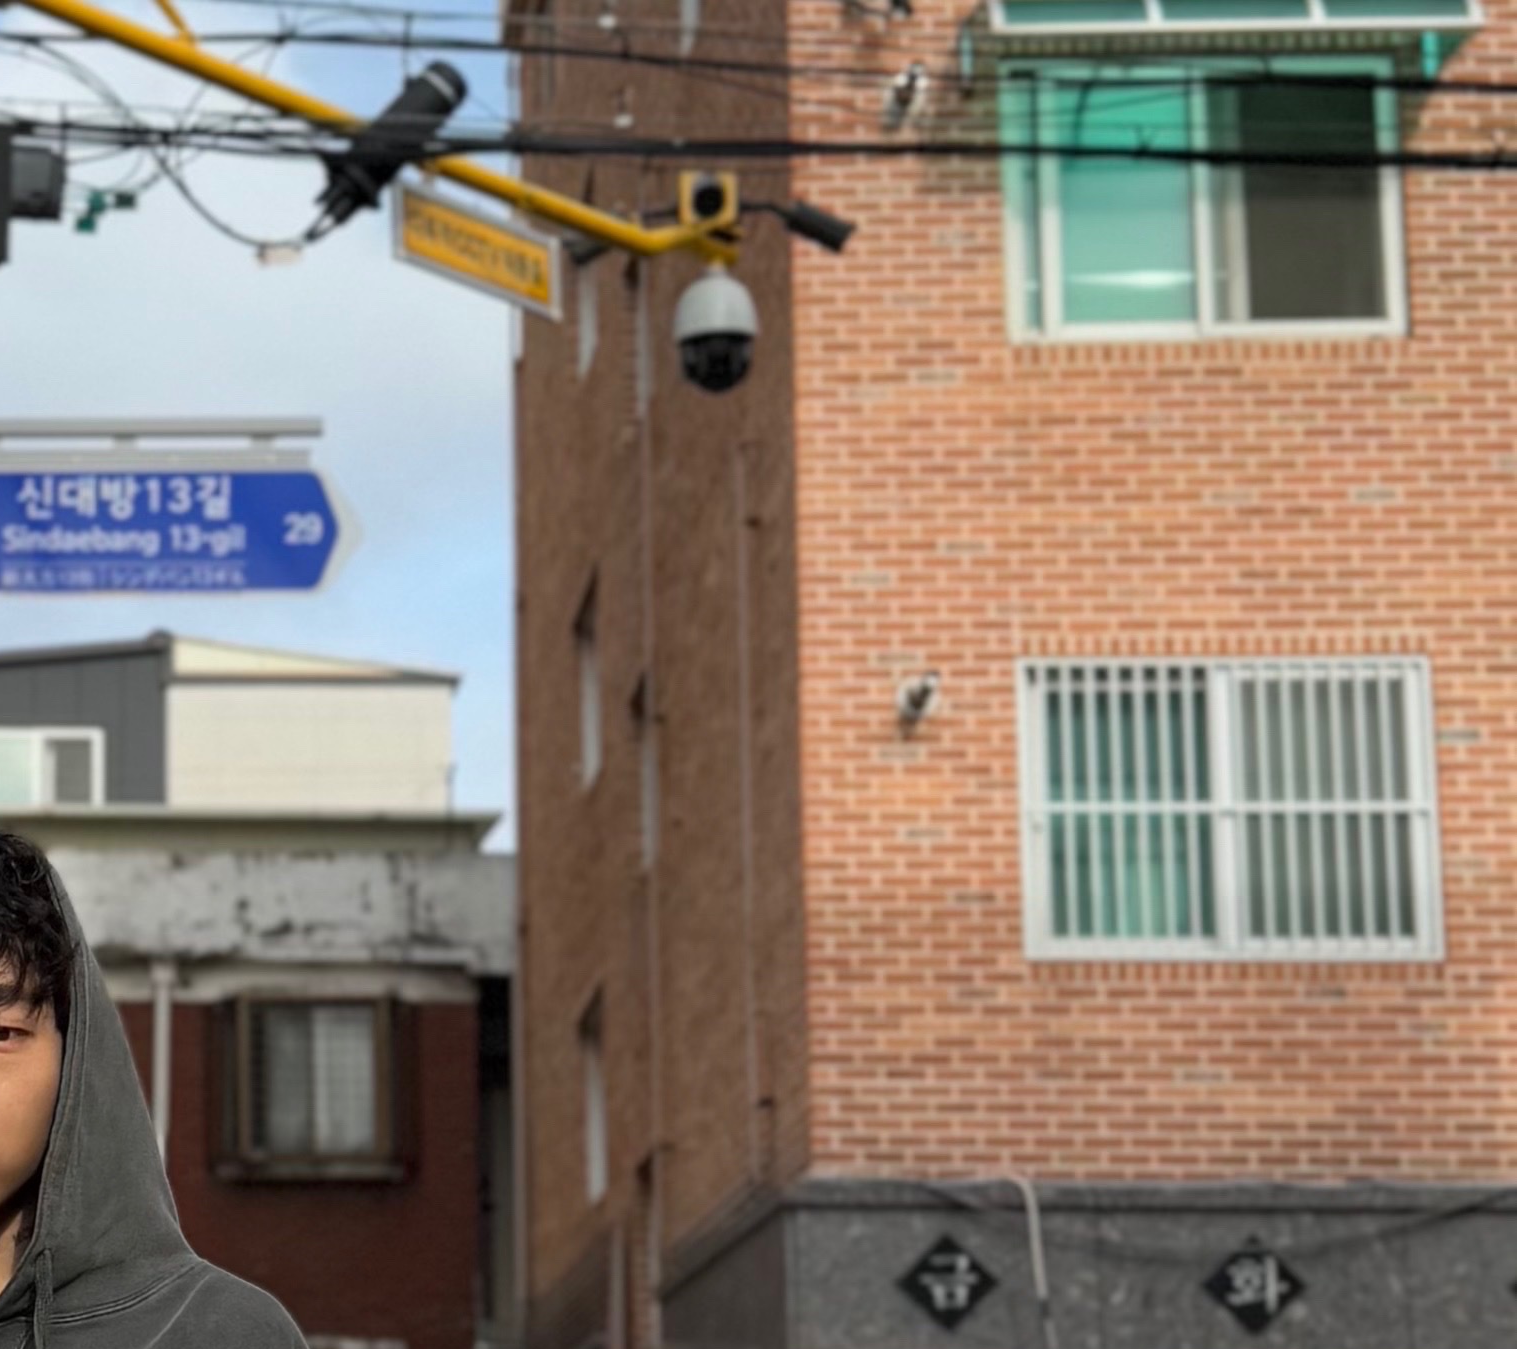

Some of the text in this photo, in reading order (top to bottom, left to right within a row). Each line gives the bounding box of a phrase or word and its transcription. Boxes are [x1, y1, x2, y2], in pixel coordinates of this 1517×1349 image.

[16, 475, 233, 519] 신대방13길
[1, 525, 247, 556] Sindaebang 13-gil
[284, 513, 324, 545] 29
